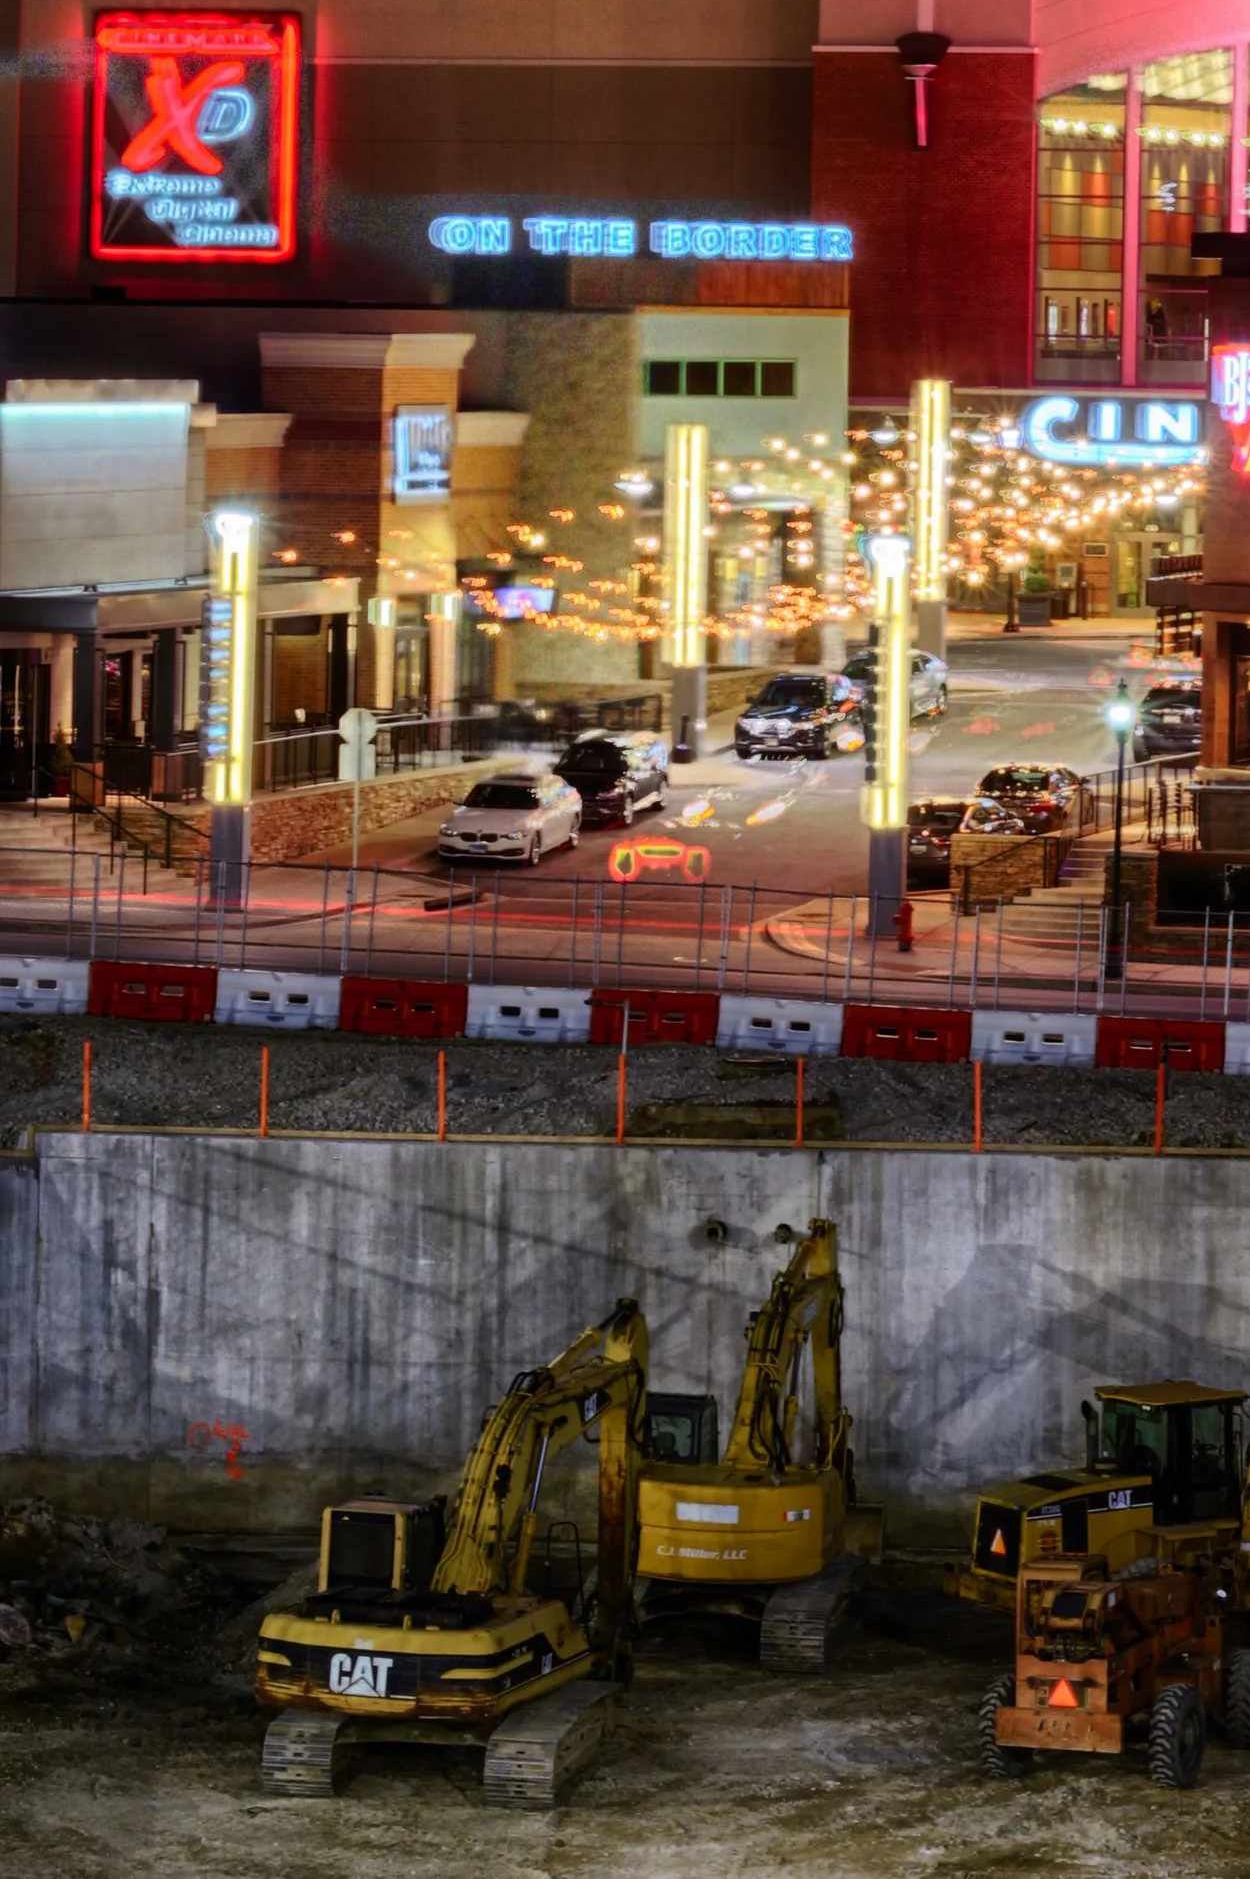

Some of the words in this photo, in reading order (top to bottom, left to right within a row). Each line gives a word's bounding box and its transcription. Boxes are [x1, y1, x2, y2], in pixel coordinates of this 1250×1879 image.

[121, 53, 256, 174] XD
[430, 215, 510, 254] ON
[524, 217, 637, 257] THE
[651, 221, 853, 260] BORDER
[1108, 1489, 1133, 1510] CAT
[329, 1653, 394, 1698] CAT
